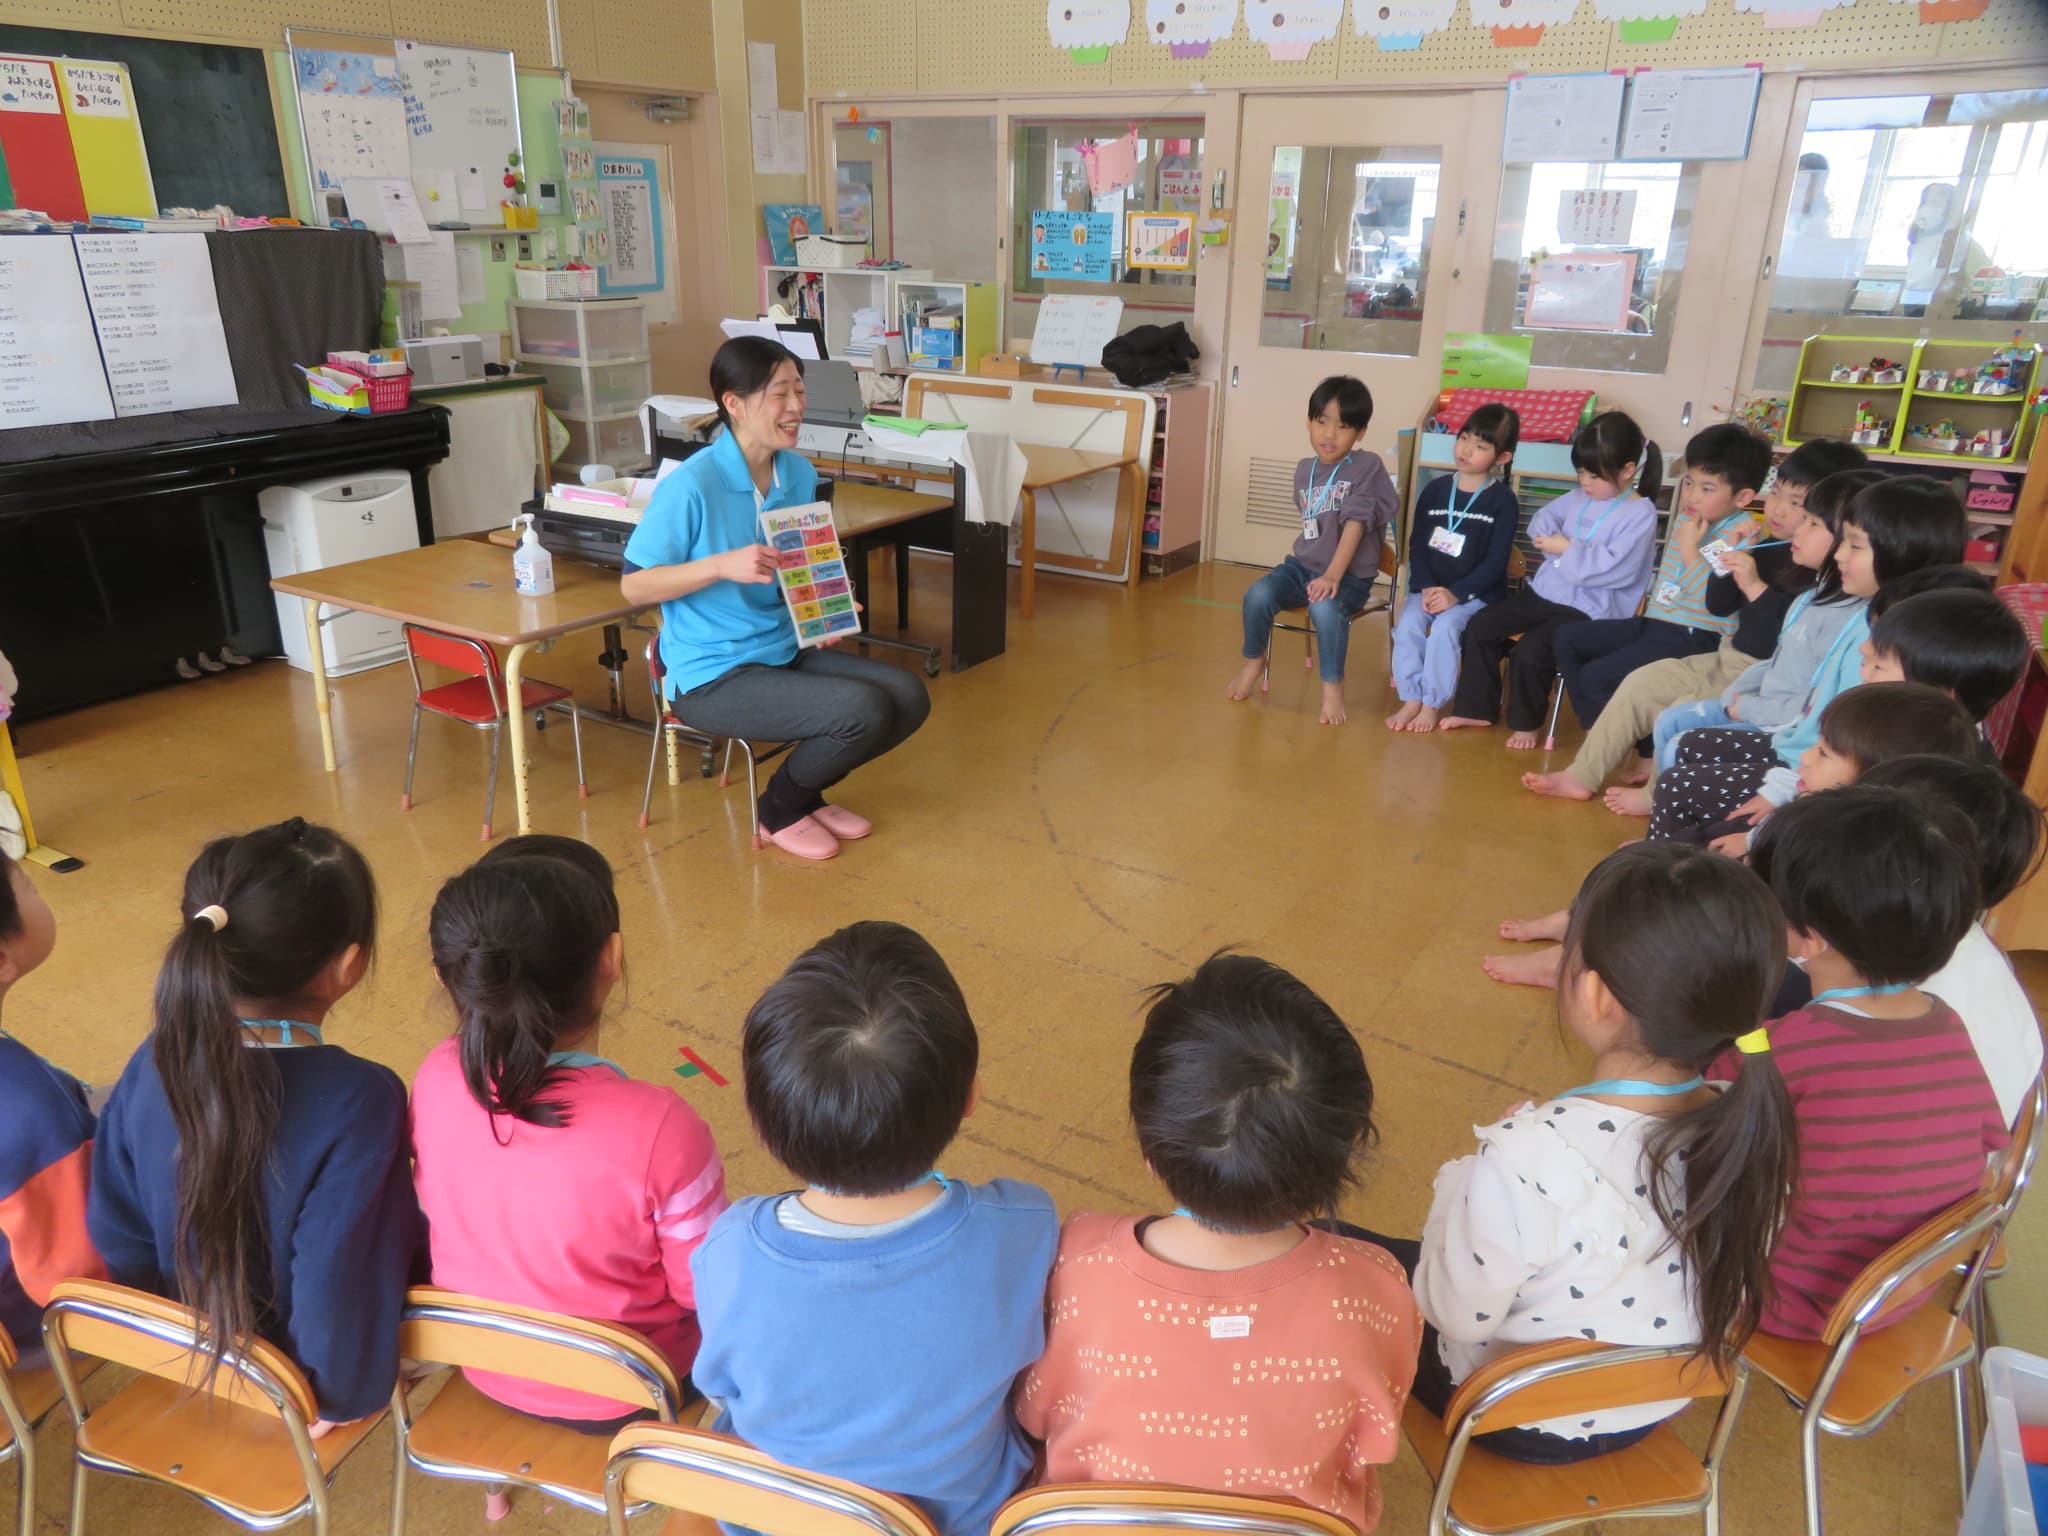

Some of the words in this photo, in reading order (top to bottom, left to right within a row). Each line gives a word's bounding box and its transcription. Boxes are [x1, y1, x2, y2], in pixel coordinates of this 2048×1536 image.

[21, 88, 54, 100] たべもの
[92, 95, 121, 106] たべもの
